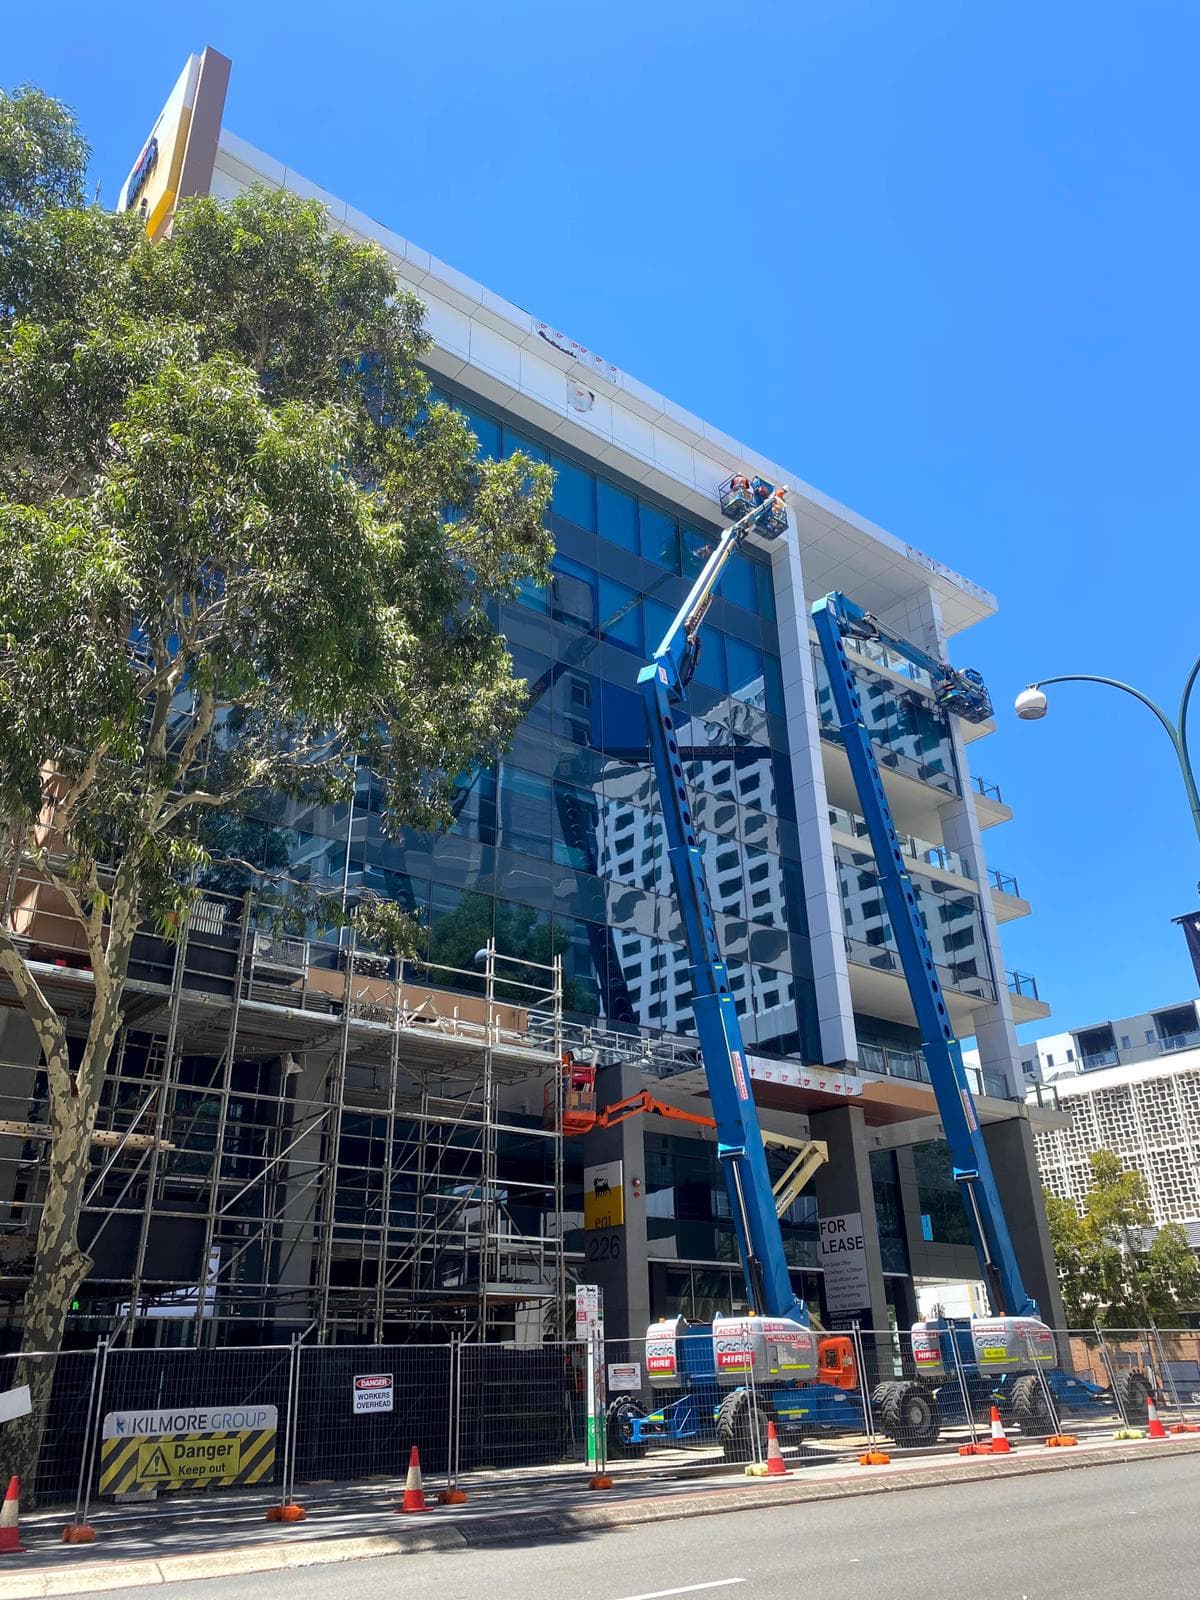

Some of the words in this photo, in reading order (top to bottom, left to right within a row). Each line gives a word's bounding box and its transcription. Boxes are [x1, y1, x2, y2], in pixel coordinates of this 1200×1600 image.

[820, 1219, 846, 1235] FOR
[590, 1234, 621, 1263] 226
[821, 1236, 864, 1255] LEASE
[975, 1336, 1008, 1348] Genie
[722, 1354, 751, 1364] HIRE
[917, 1351, 937, 1360] HIRE
[650, 1360, 671, 1368] HIRE
[361, 1379, 387, 1387] DANGER
[357, 1392, 390, 1401] WORKERS
[356, 1400, 391, 1410] OVERHEAD
[132, 1414, 207, 1434] KILMORE
[211, 1411, 267, 1430] GROUP
[174, 1443, 234, 1461] Danger
[178, 1465, 206, 1477] Keep
[209, 1463, 225, 1474] out
